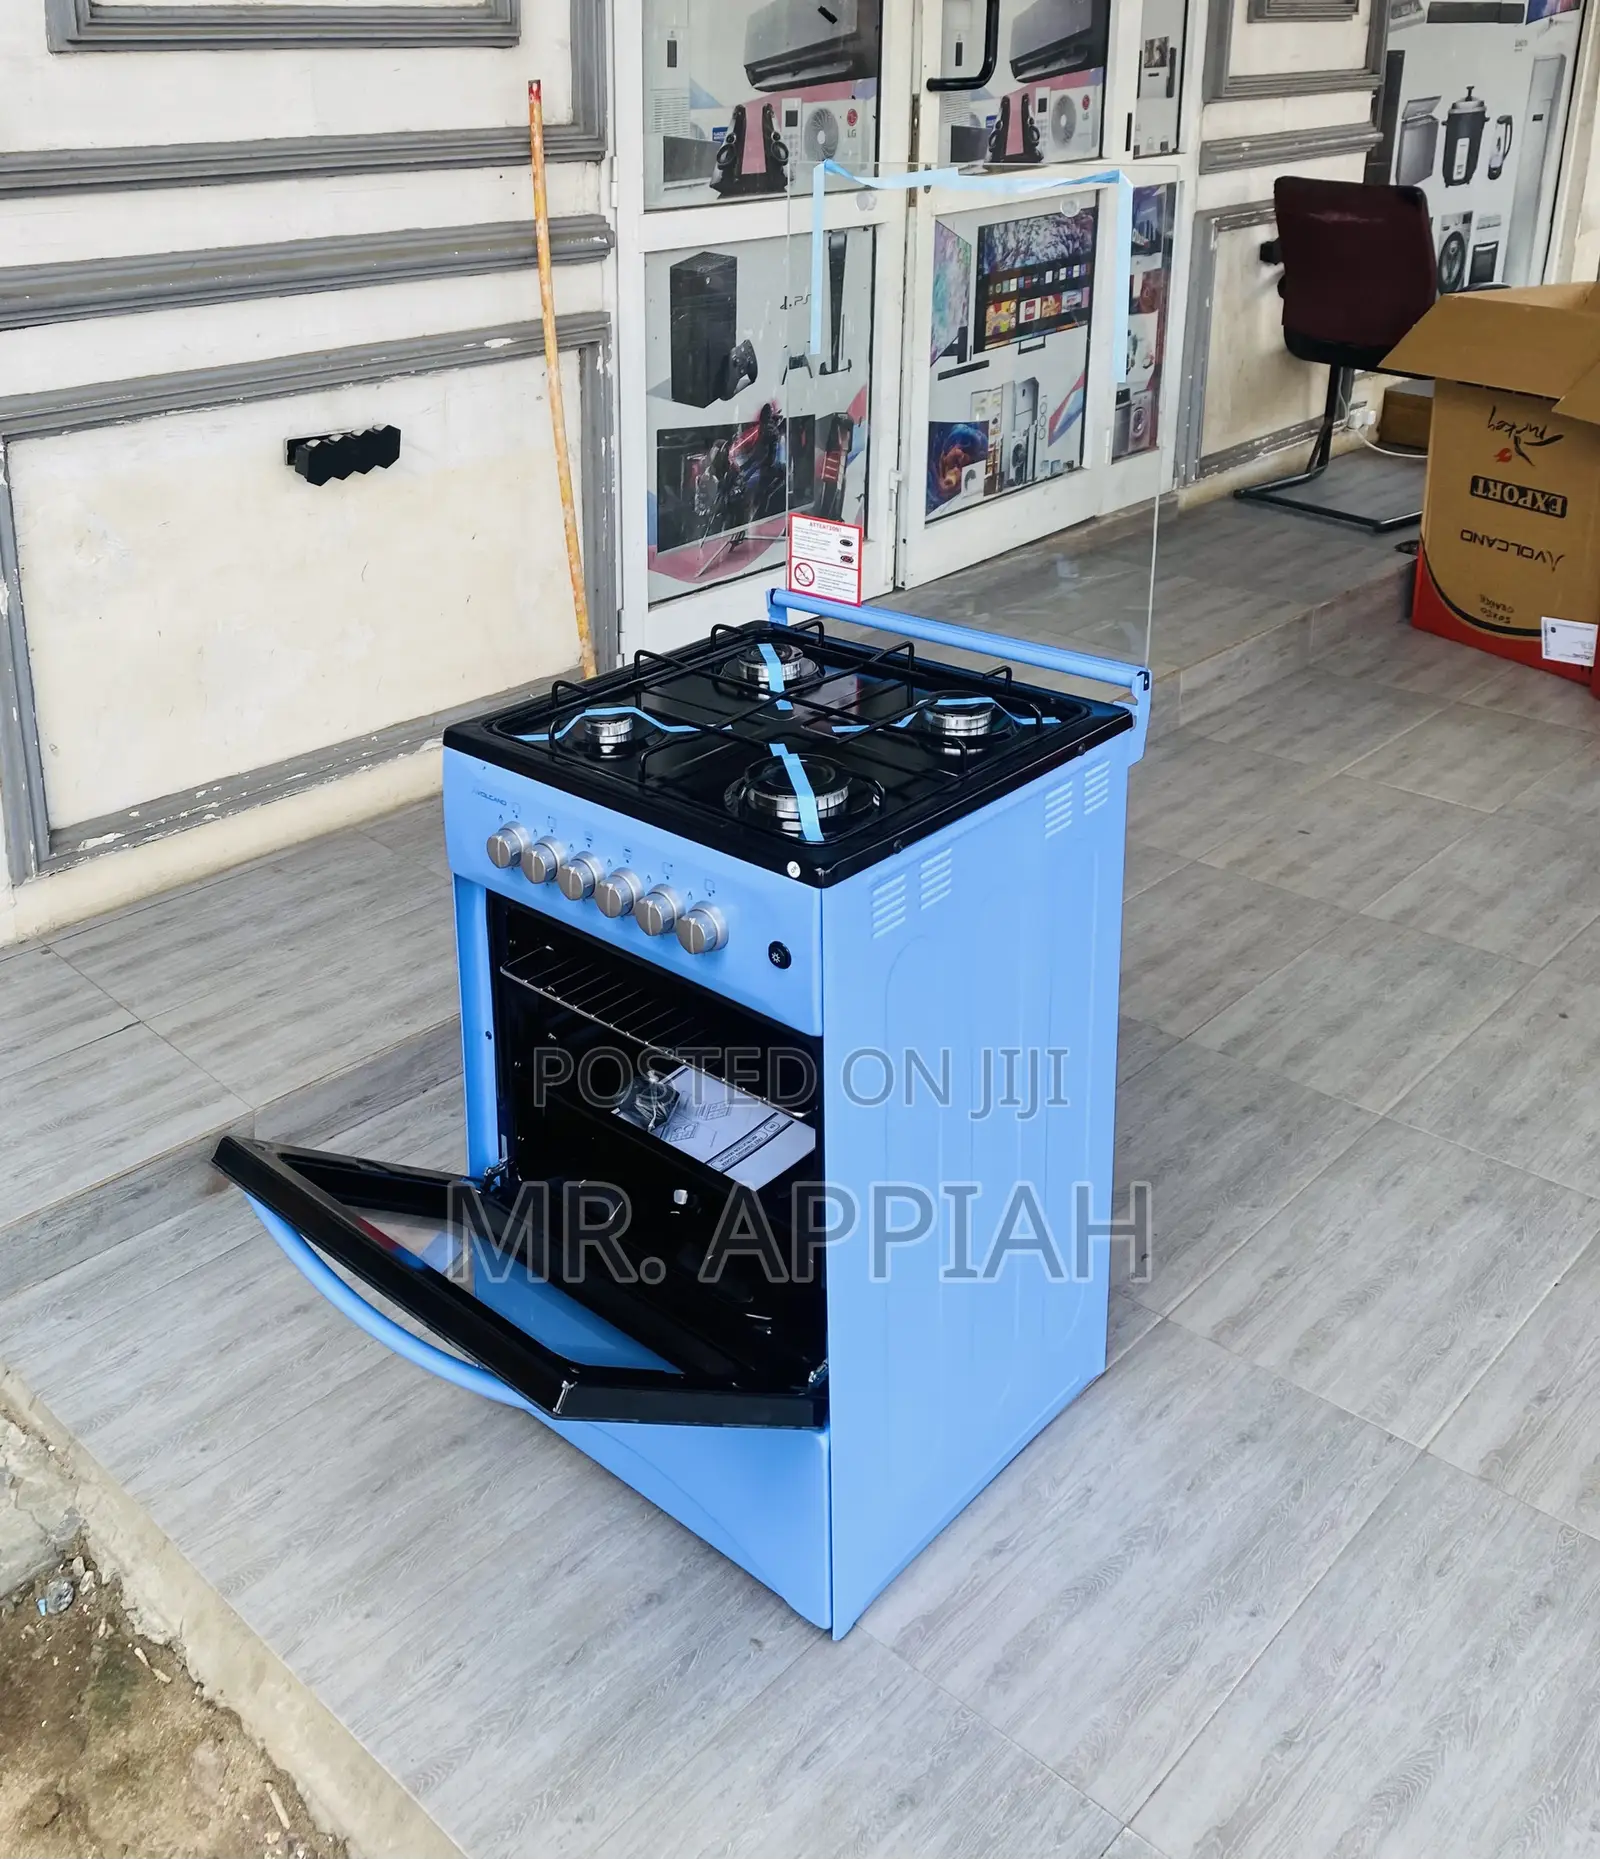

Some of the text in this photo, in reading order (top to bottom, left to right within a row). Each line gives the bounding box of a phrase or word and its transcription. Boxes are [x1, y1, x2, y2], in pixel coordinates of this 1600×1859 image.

[847, 130, 857, 138] LG
[1472, 478, 1564, 516] EXPORT
[1460, 529, 1547, 563] VOLCANO
